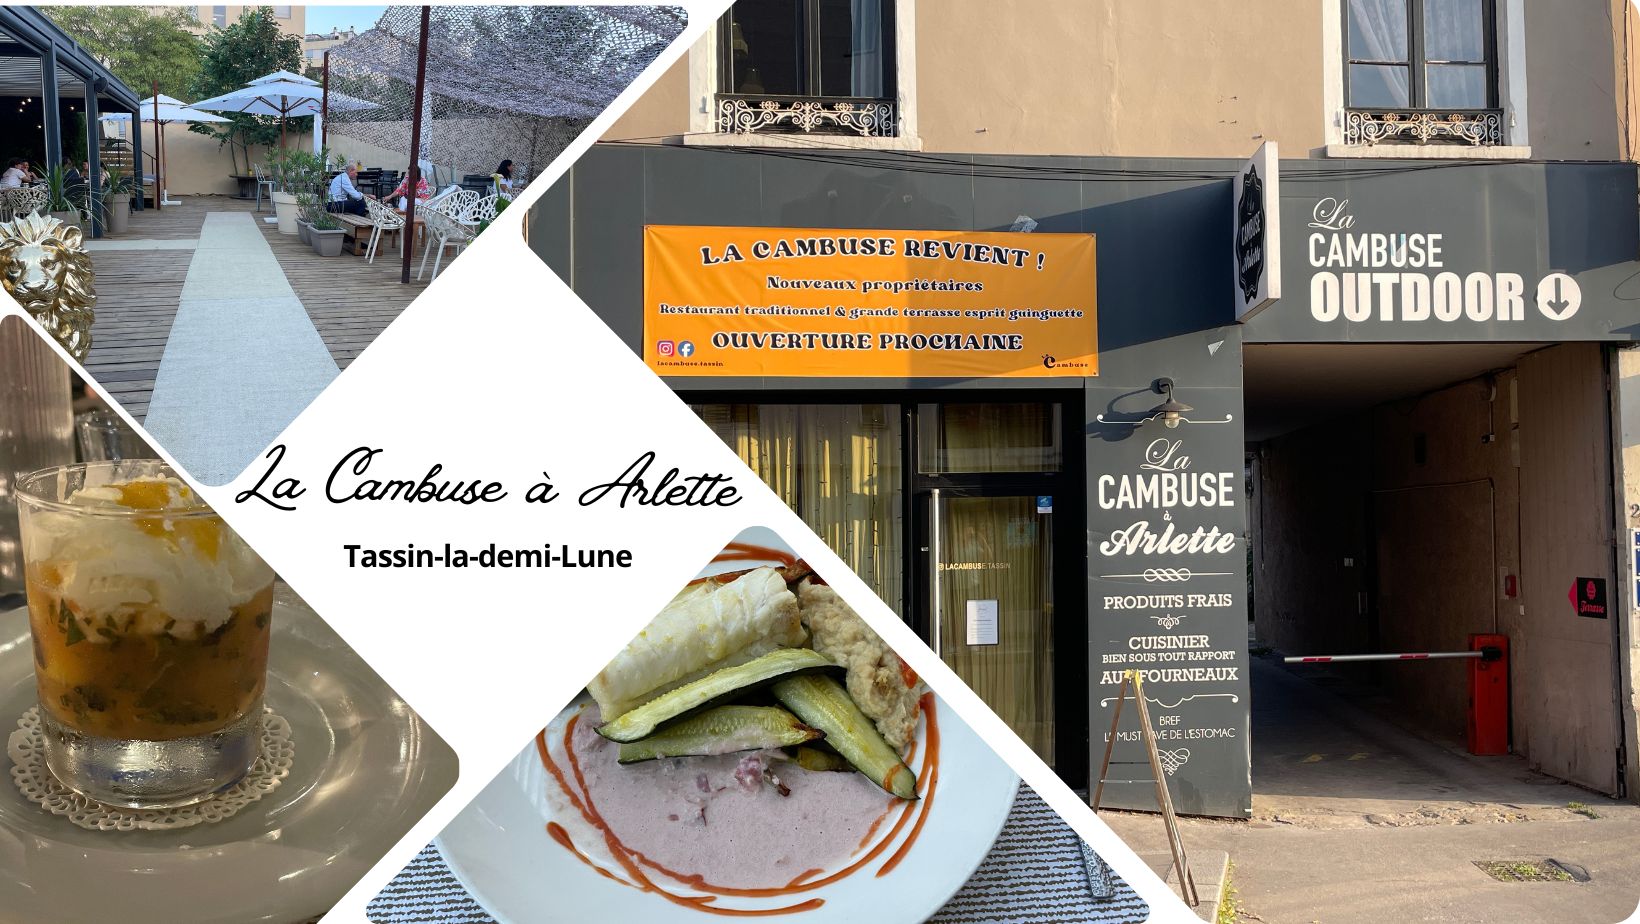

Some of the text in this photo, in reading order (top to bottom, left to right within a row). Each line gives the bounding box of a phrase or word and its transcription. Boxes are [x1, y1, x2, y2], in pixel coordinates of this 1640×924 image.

[1308, 197, 1355, 229] La
[701, 244, 744, 265] LA
[752, 238, 896, 259] CAMBUSE
[903, 239, 1029, 268] REVIENT
[1309, 233, 1443, 268] CAMBUSE
[767, 276, 984, 293] Nouveaux propriétaires
[1310, 271, 1525, 322] OUTDOOR
[659, 303, 1084, 321] Restaurant traditionnel & grande terrasse esprit guinguette
[711, 332, 1024, 351] OUVERTURE PROCHAINE
[1042, 354, 1089, 369] Cambuse
[1140, 438, 1191, 471] La
[1098, 472, 1235, 510] CAMBUSE
[1163, 510, 1172, 521] à
[1100, 520, 1236, 556] Arlette
[1103, 594, 1233, 610] PRODUITS FRAIS
[1128, 635, 1210, 650] CUISINIER
[1102, 651, 1235, 663] BIEN SOUS TOUT RAPPORT
[1138, 668, 1239, 682] FOURNEAUX
[1159, 716, 1181, 726] BREF
[1116, 731, 1142, 742] MUST
[1147, 730, 1167, 740] AVE
[1170, 730, 1182, 740] DE
